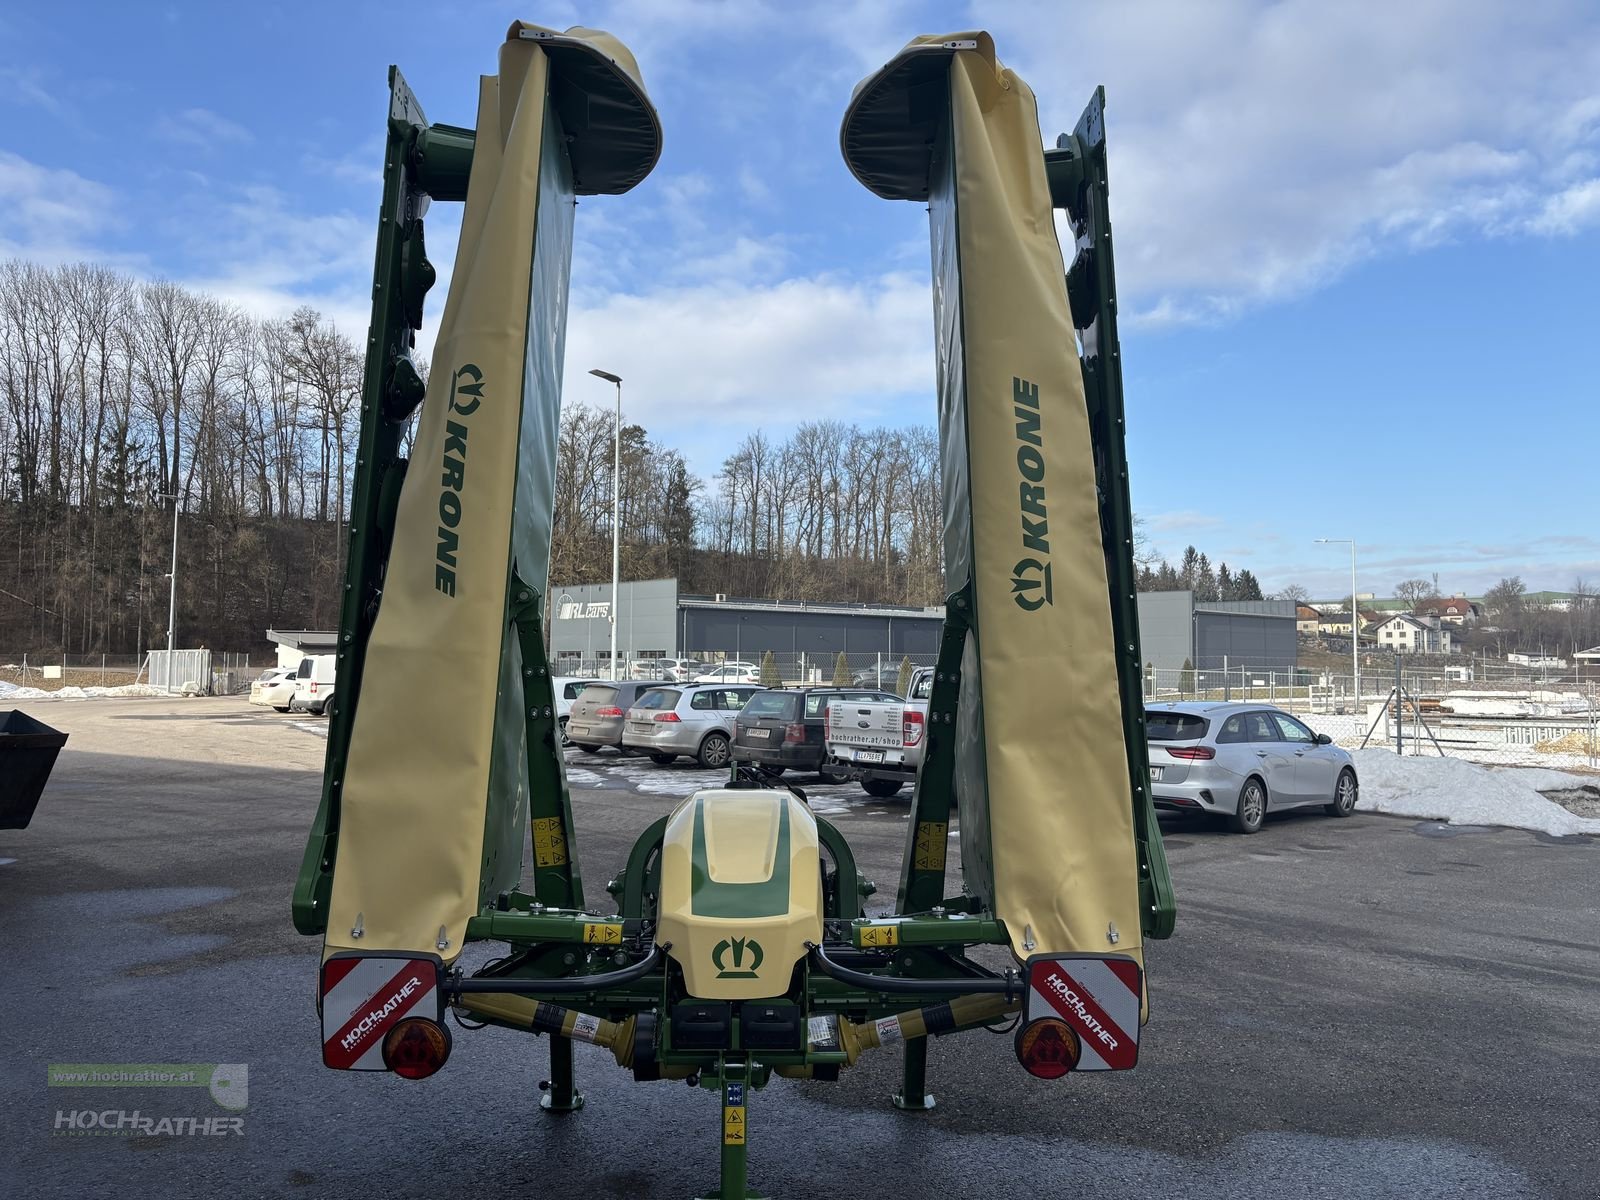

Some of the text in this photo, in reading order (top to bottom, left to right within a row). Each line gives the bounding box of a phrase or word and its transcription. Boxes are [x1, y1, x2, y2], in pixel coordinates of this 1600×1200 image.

[1013, 376, 1050, 554] KRONE
[436, 420, 468, 598] KRONE
[586, 605, 609, 618] cars
[831, 734, 901, 747] hochrather.at/shop
[340, 976, 422, 1049] HOCHRATHER
[1047, 973, 1118, 1051] HOCHRATHER
